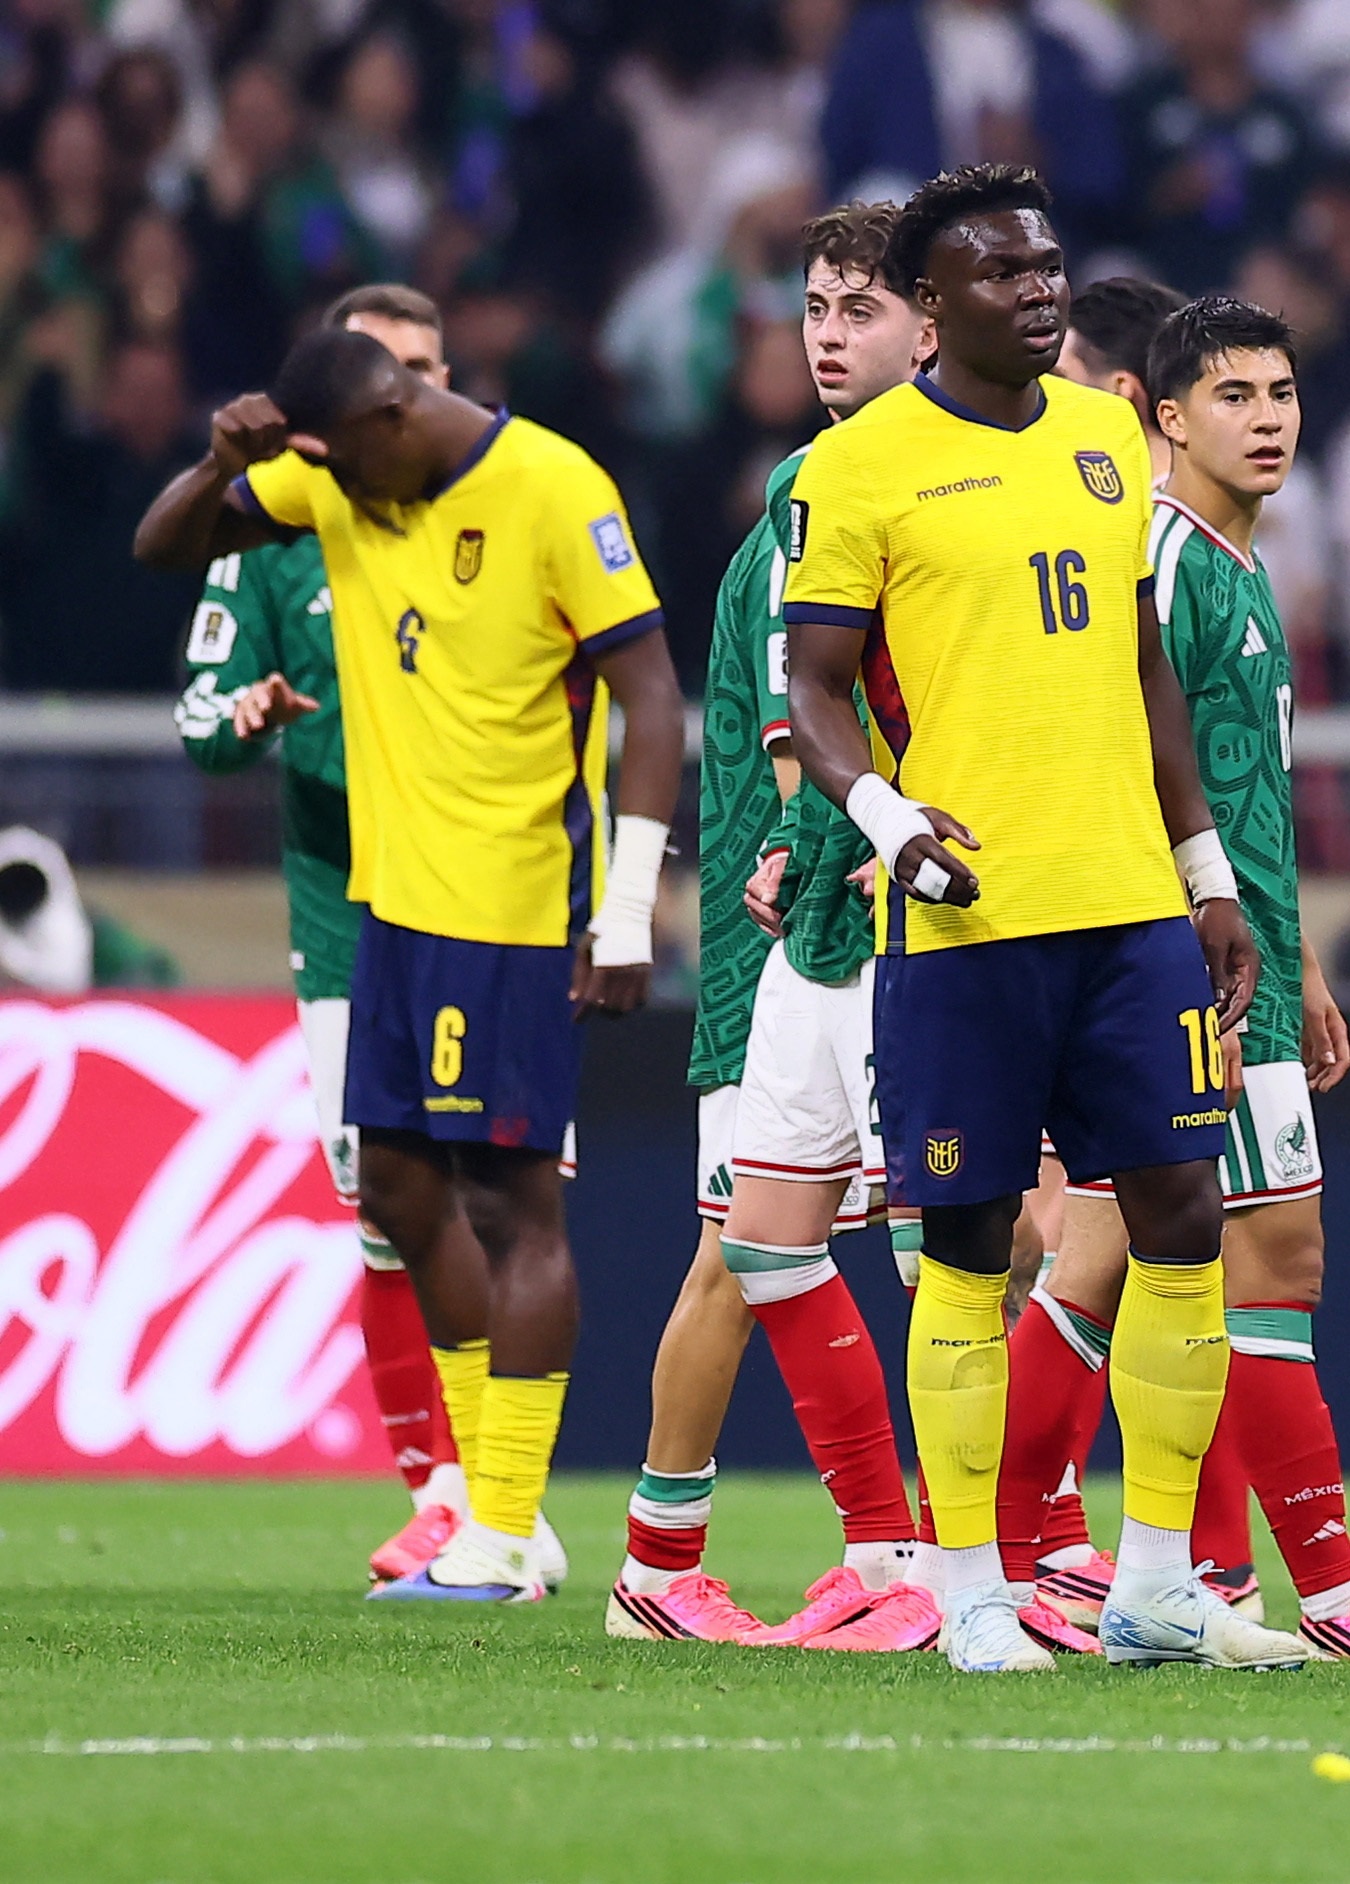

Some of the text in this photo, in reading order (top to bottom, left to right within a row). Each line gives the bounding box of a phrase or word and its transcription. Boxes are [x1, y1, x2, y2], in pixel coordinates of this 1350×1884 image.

[916, 475, 1003, 502] marathon
[1029, 549, 1090, 634] 16
[431, 1005, 466, 1087] 6
[1178, 1005, 1225, 1094] 16
[1284, 1483, 1345, 1506] MÉXIC
